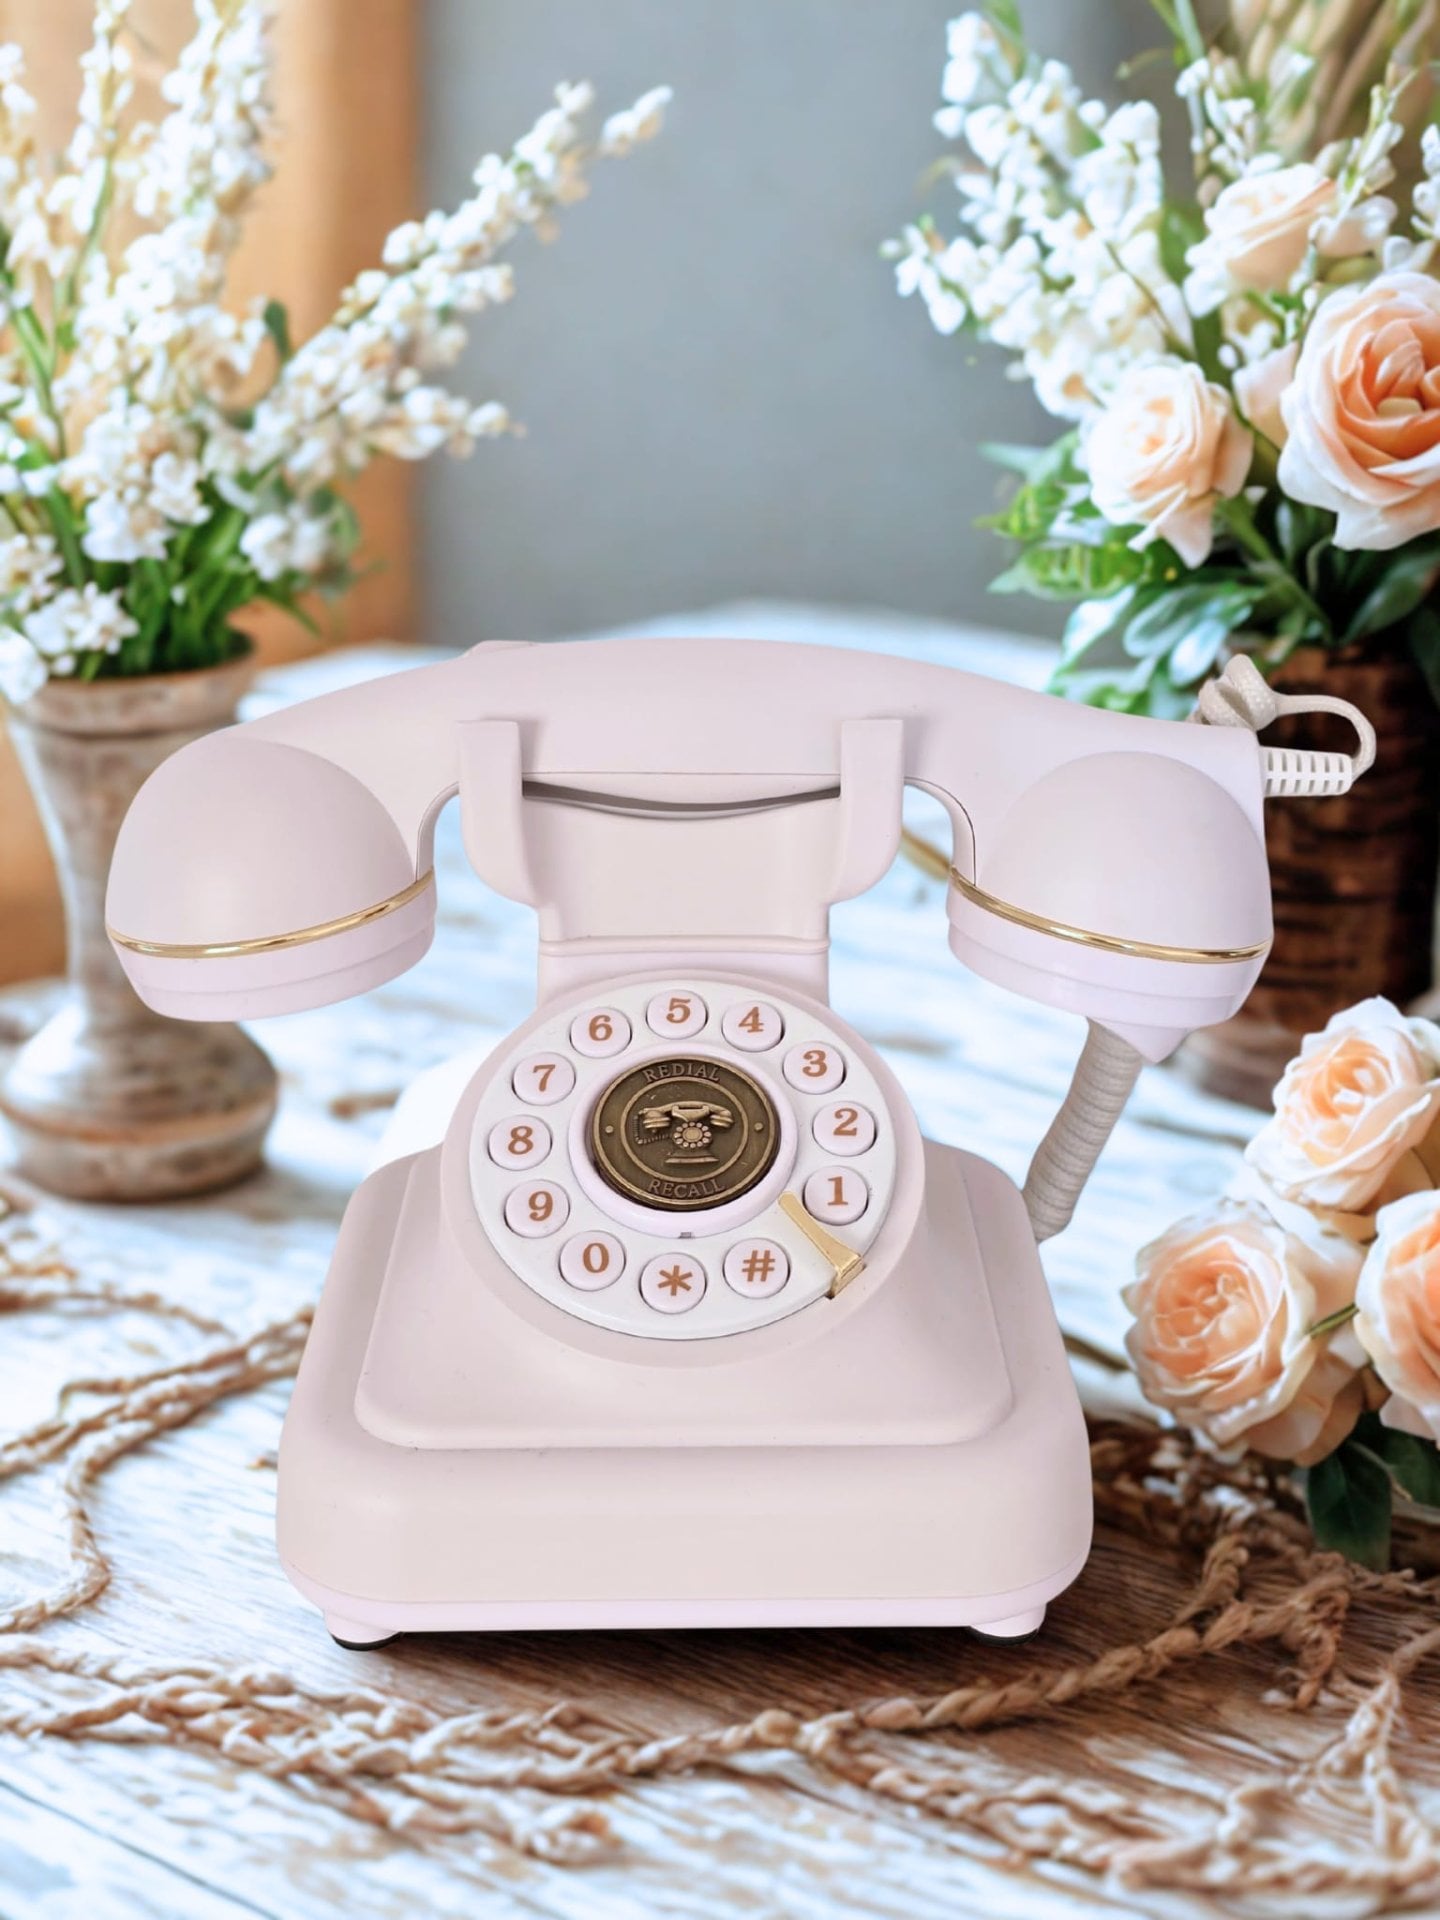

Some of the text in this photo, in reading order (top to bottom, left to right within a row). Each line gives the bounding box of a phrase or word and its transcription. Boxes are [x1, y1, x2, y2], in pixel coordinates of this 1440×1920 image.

[665, 996, 692, 1025] 5
[738, 1006, 764, 1035] 4
[586, 1014, 614, 1043] 6
[532, 1063, 557, 1093] 7
[643, 1061, 721, 1083] REDIAL
[801, 1048, 828, 1079] 3
[832, 1106, 860, 1138] 2
[507, 1125, 535, 1156] 8
[647, 1178, 726, 1199] RECALL
[826, 1175, 849, 1208] 1
[528, 1190, 555, 1223] 9
[582, 1242, 611, 1275] 0
[741, 1248, 776, 1284] #
